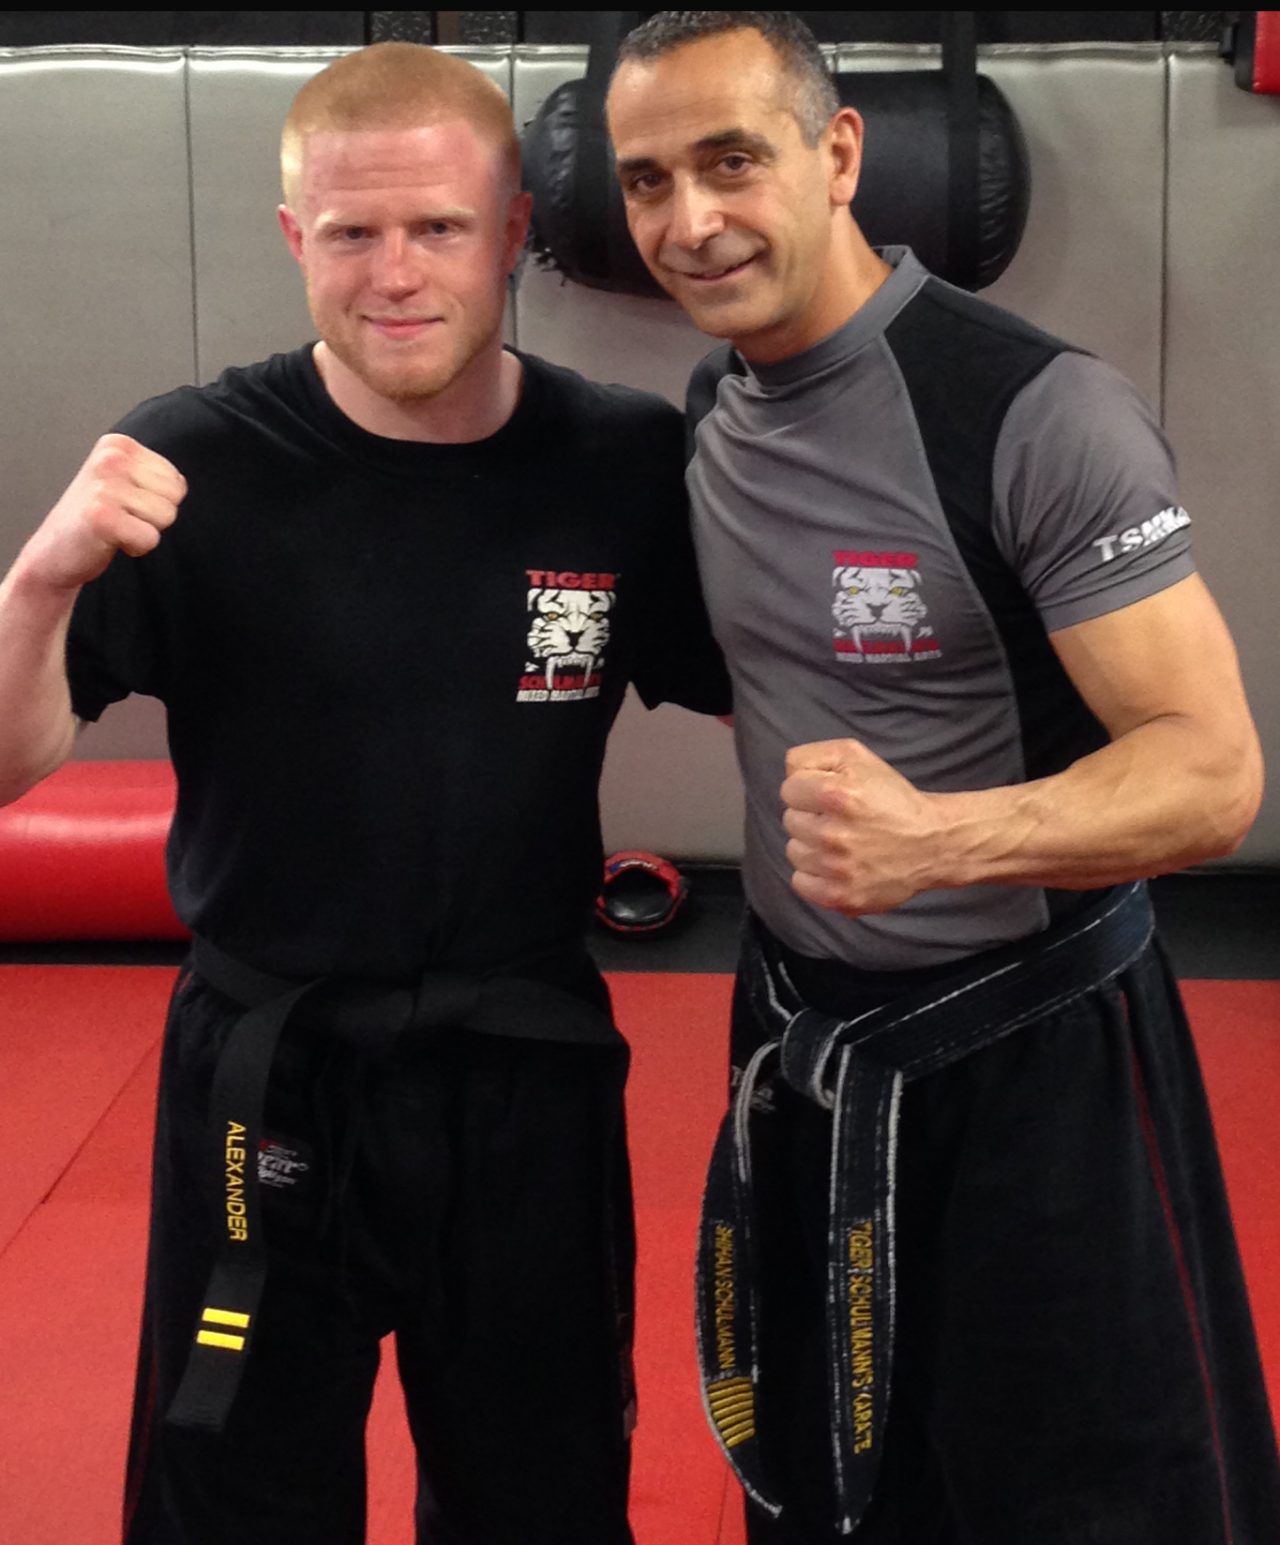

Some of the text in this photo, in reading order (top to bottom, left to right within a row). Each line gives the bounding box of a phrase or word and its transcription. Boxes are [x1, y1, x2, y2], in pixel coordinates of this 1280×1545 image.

[525, 570, 615, 589] TIGER
[225, 1120, 248, 1242] ALEXANDER
[714, 1224, 736, 1369] SHIHAN SCHULMANN
[848, 1220, 874, 1271] TIGER
[848, 1274, 874, 1388] SCHULMANN'S
